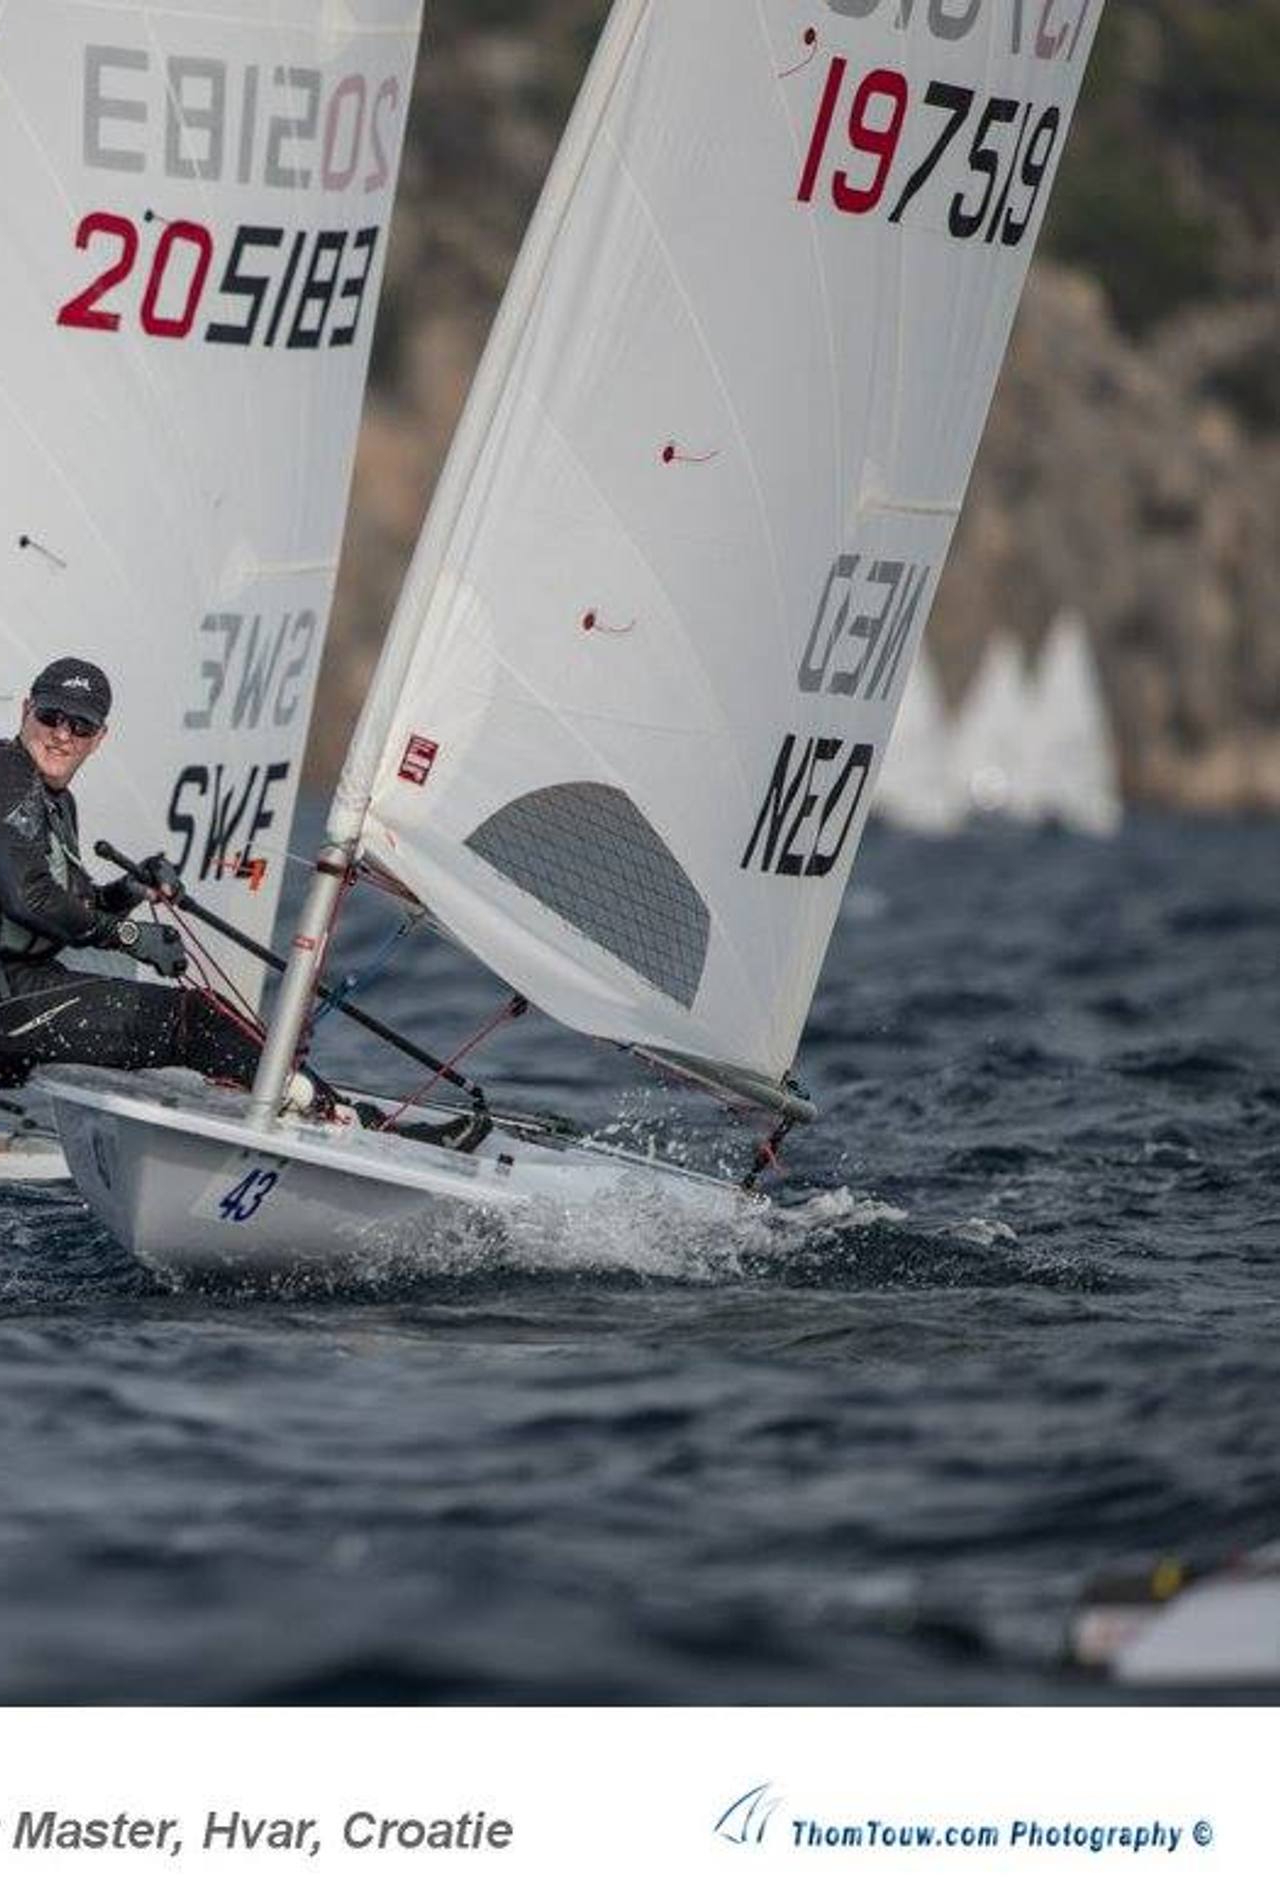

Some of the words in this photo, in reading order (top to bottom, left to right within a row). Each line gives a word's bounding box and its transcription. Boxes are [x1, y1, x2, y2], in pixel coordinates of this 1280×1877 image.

[797, 56, 1061, 247] 197519
[56, 211, 380, 350] 205183
[167, 762, 291, 882] SWE
[739, 733, 874, 878] NED
[219, 1168, 279, 1223] 43
